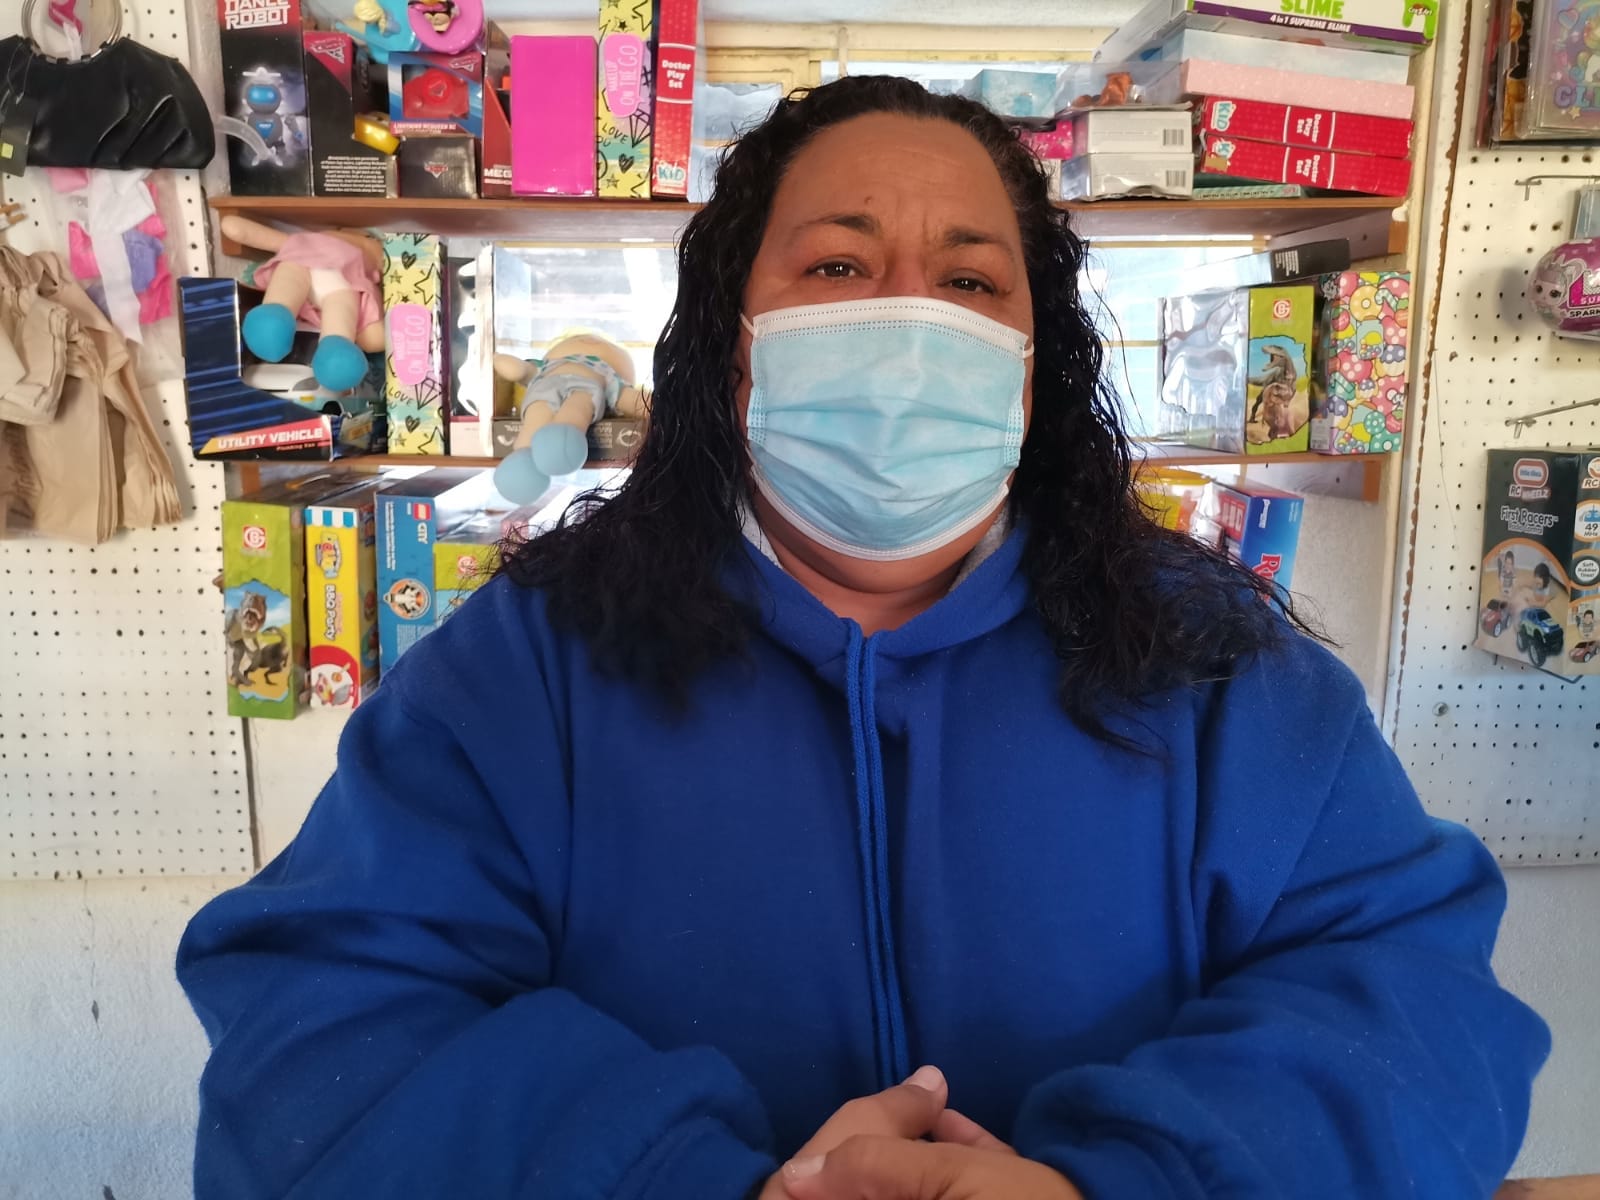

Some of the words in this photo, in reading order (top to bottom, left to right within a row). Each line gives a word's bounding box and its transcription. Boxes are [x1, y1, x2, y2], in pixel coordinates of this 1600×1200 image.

[225, 5, 291, 30] ROBOT
[1280, 0, 1344, 19] SLIME
[1289, 17, 1327, 29] SUPREME
[617, 45, 638, 67] GO
[662, 59, 692, 71] Doctor
[667, 70, 686, 81] Play
[668, 79, 683, 89] Set
[602, 123, 628, 144] LOVE
[1296, 119, 1304, 133] Set
[1303, 118, 1312, 136] Play
[1311, 113, 1322, 143] Doctor
[1296, 160, 1304, 174] Set
[1302, 159, 1312, 177] Play
[1311, 155, 1321, 183] Doctor
[218, 434, 266, 448] UTILITY
[270, 427, 323, 443] VEHICLE
[1501, 505, 1520, 521] First
[417, 522, 429, 545] CITY
[1585, 523, 1598, 532] 49
[325, 584, 336, 609] BBQ
[324, 610, 336, 641] Party
